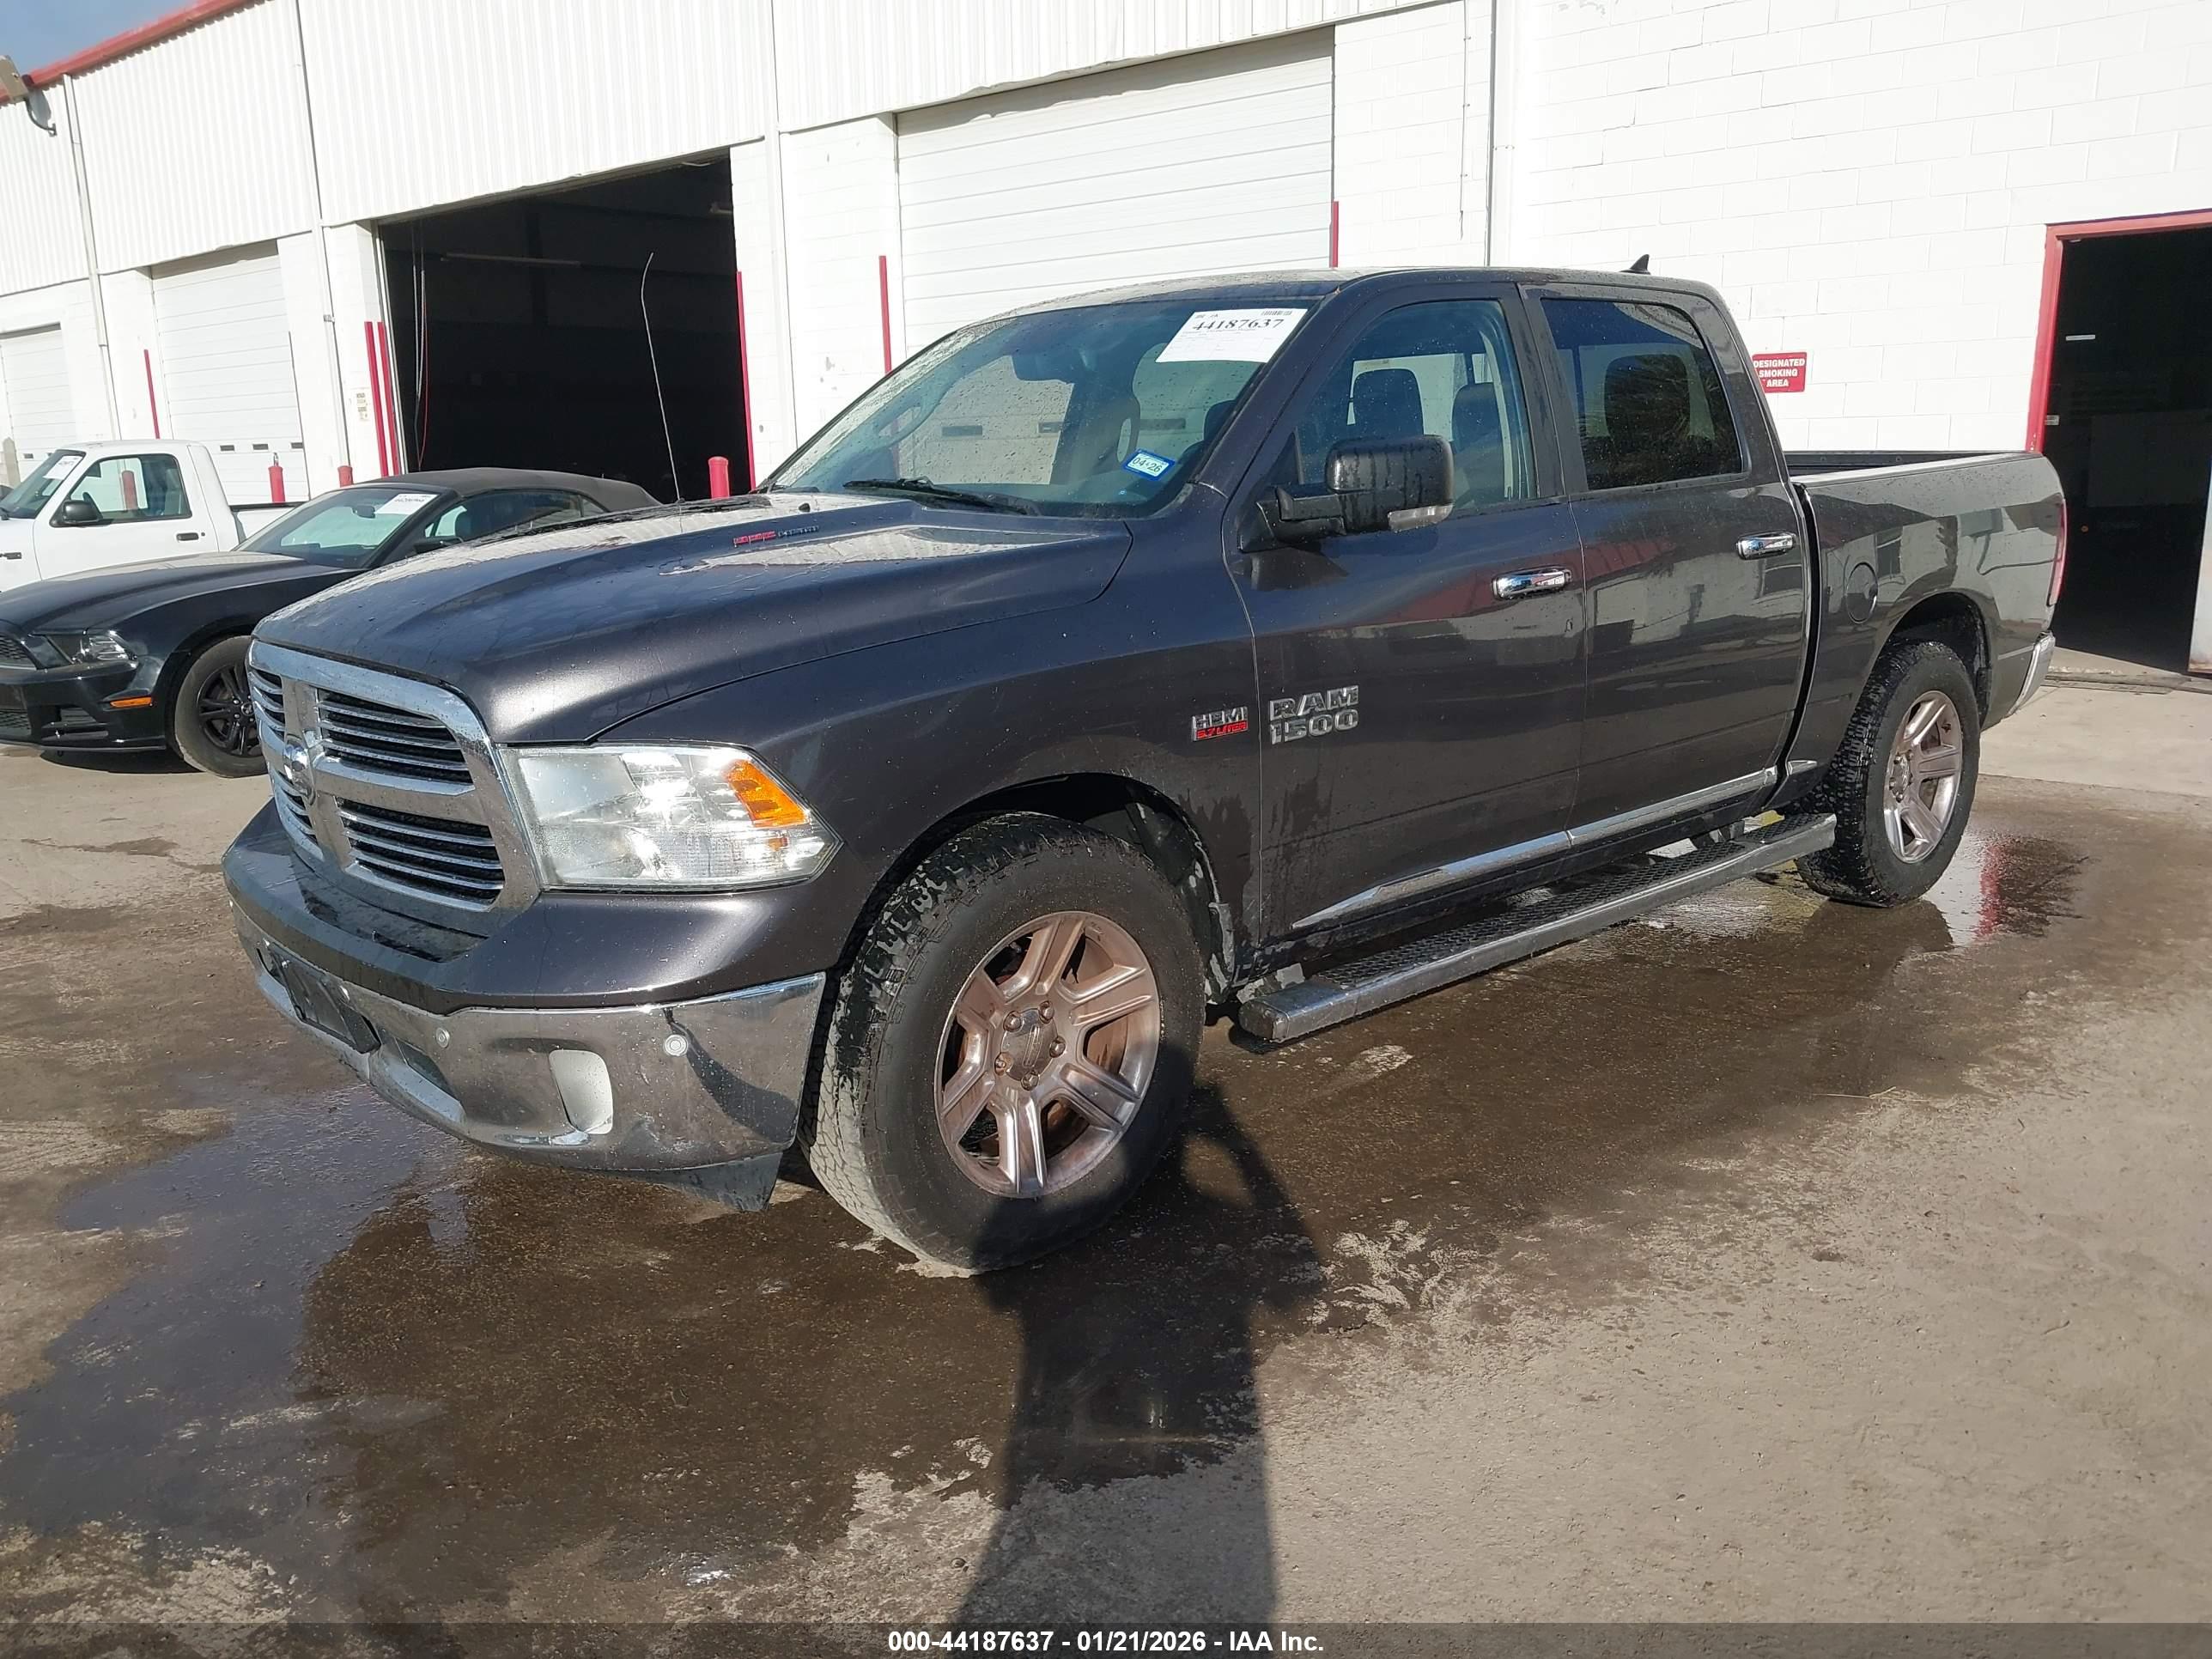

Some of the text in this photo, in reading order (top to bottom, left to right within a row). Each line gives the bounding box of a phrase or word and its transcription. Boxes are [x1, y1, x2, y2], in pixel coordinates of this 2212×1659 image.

[1193, 319, 1285, 331] 44187637
[1753, 358, 1805, 368] DESIGNATED
[1759, 368, 1798, 378] SMOKING
[1765, 379, 1789, 387] AREA
[1269, 685, 1359, 721] RAM
[1192, 706, 1248, 729] HEMI
[1270, 709, 1359, 744] 1500
